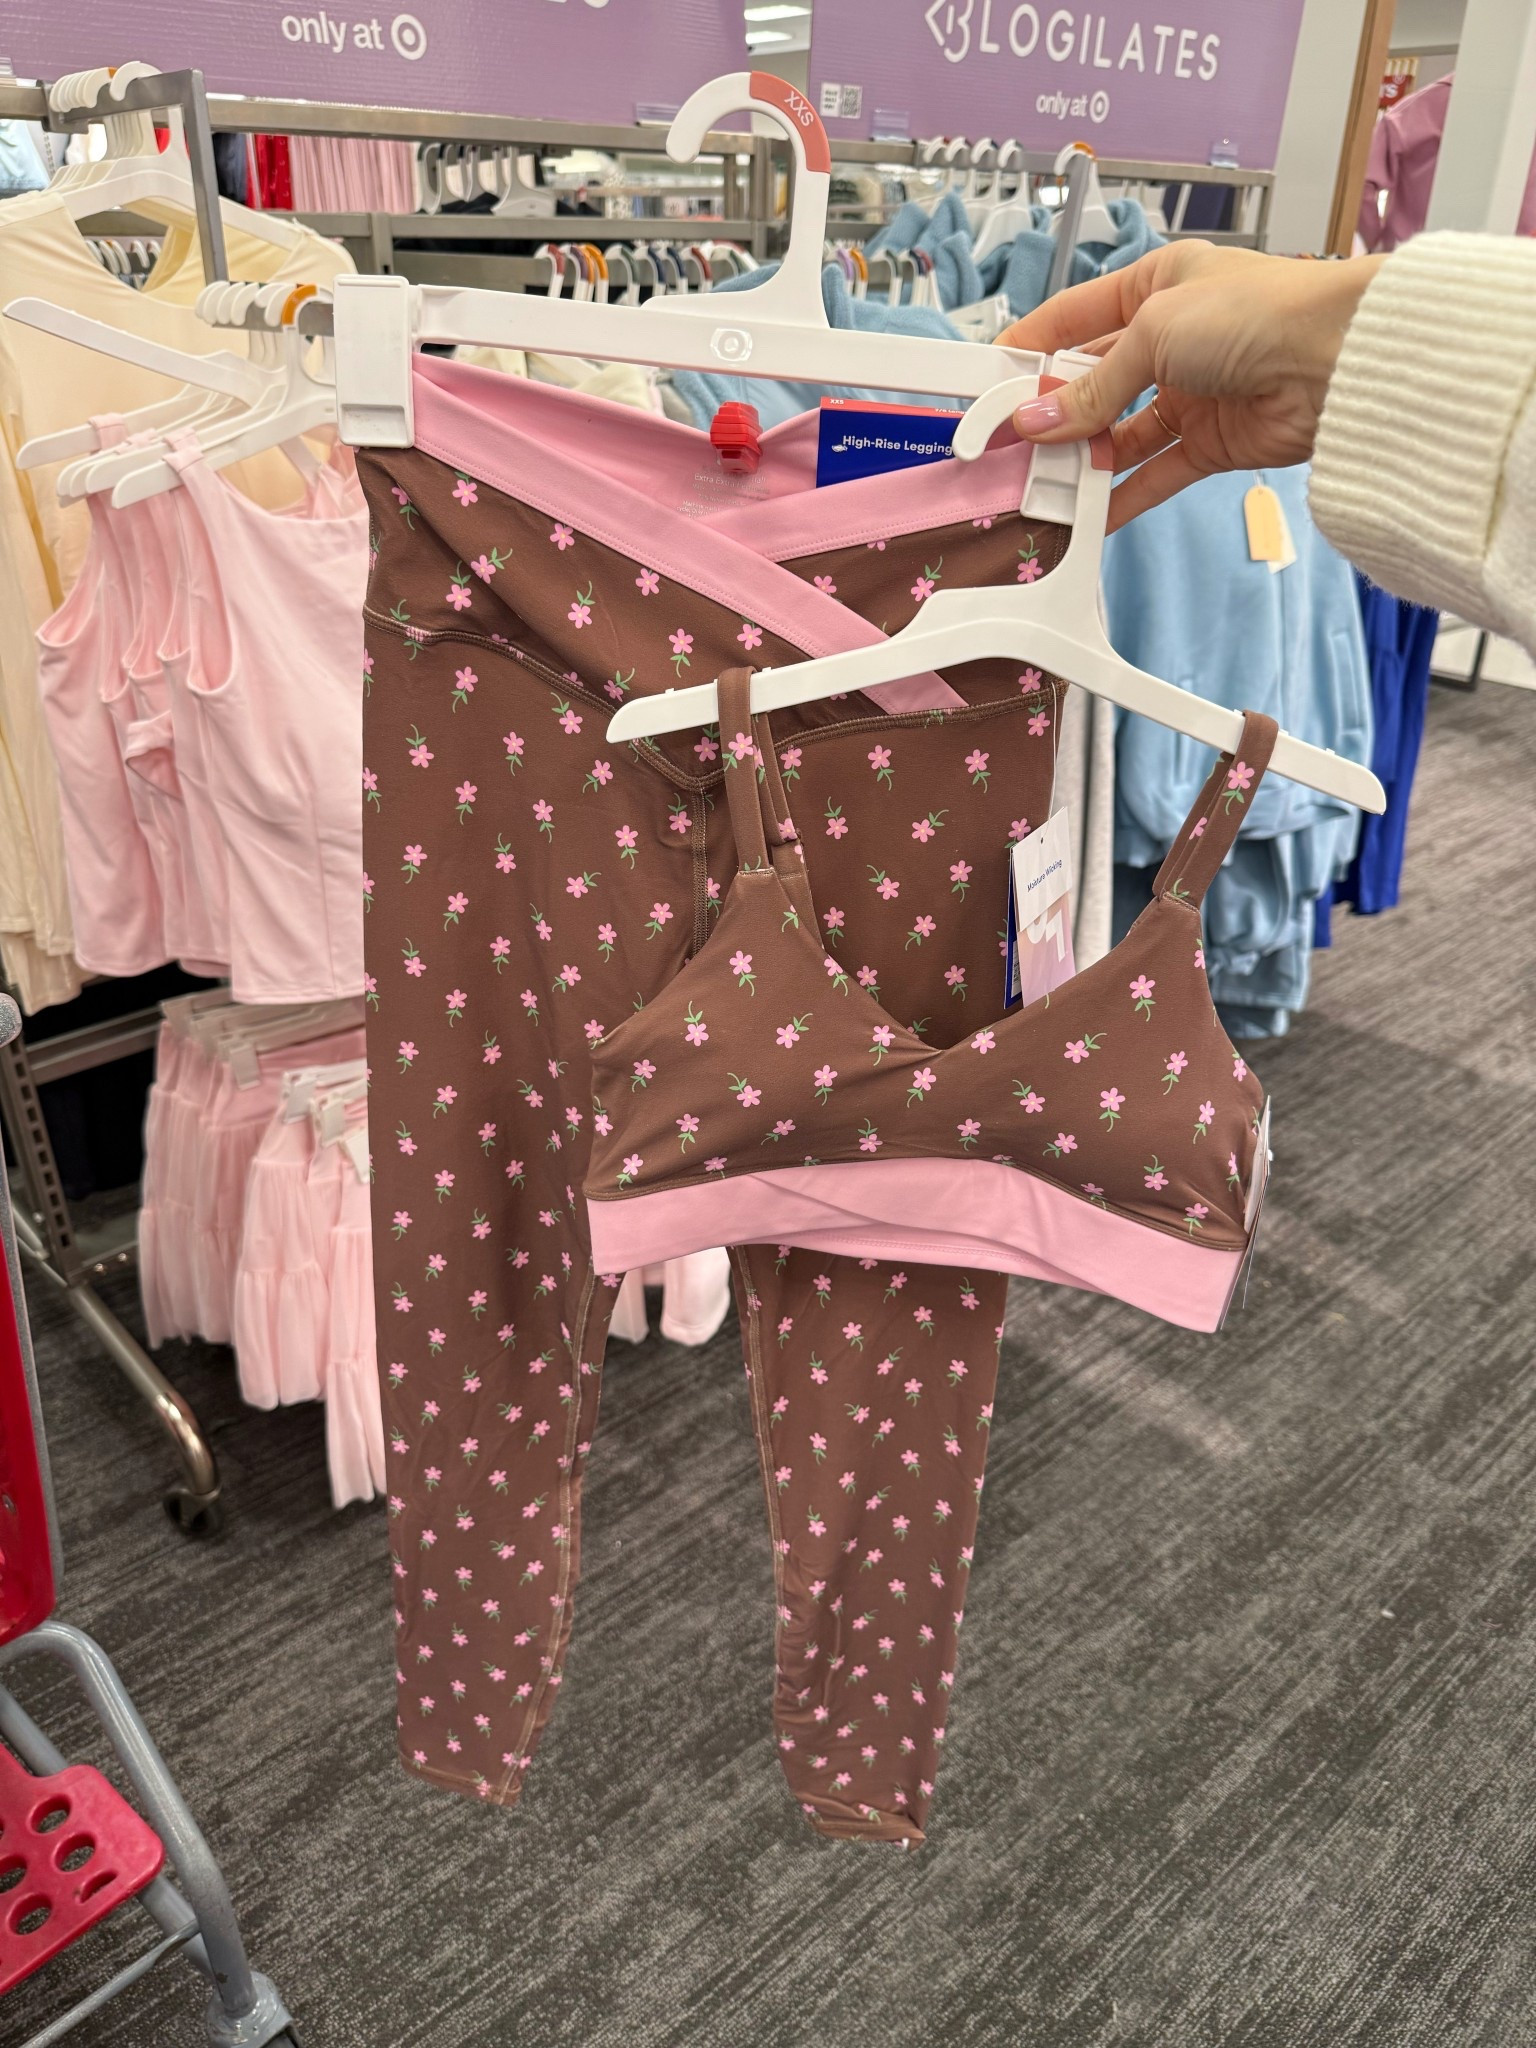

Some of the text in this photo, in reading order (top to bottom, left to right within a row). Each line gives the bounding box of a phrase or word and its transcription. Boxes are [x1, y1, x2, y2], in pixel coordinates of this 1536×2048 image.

[281, 11, 384, 53] only at
[925, 0, 1221, 81] BLOGILATES
[784, 90, 814, 127] XXS
[1036, 91, 1088, 120] only at
[842, 435, 901, 450] High-Rise
[1027, 859, 1062, 893] Moisture Wicking
